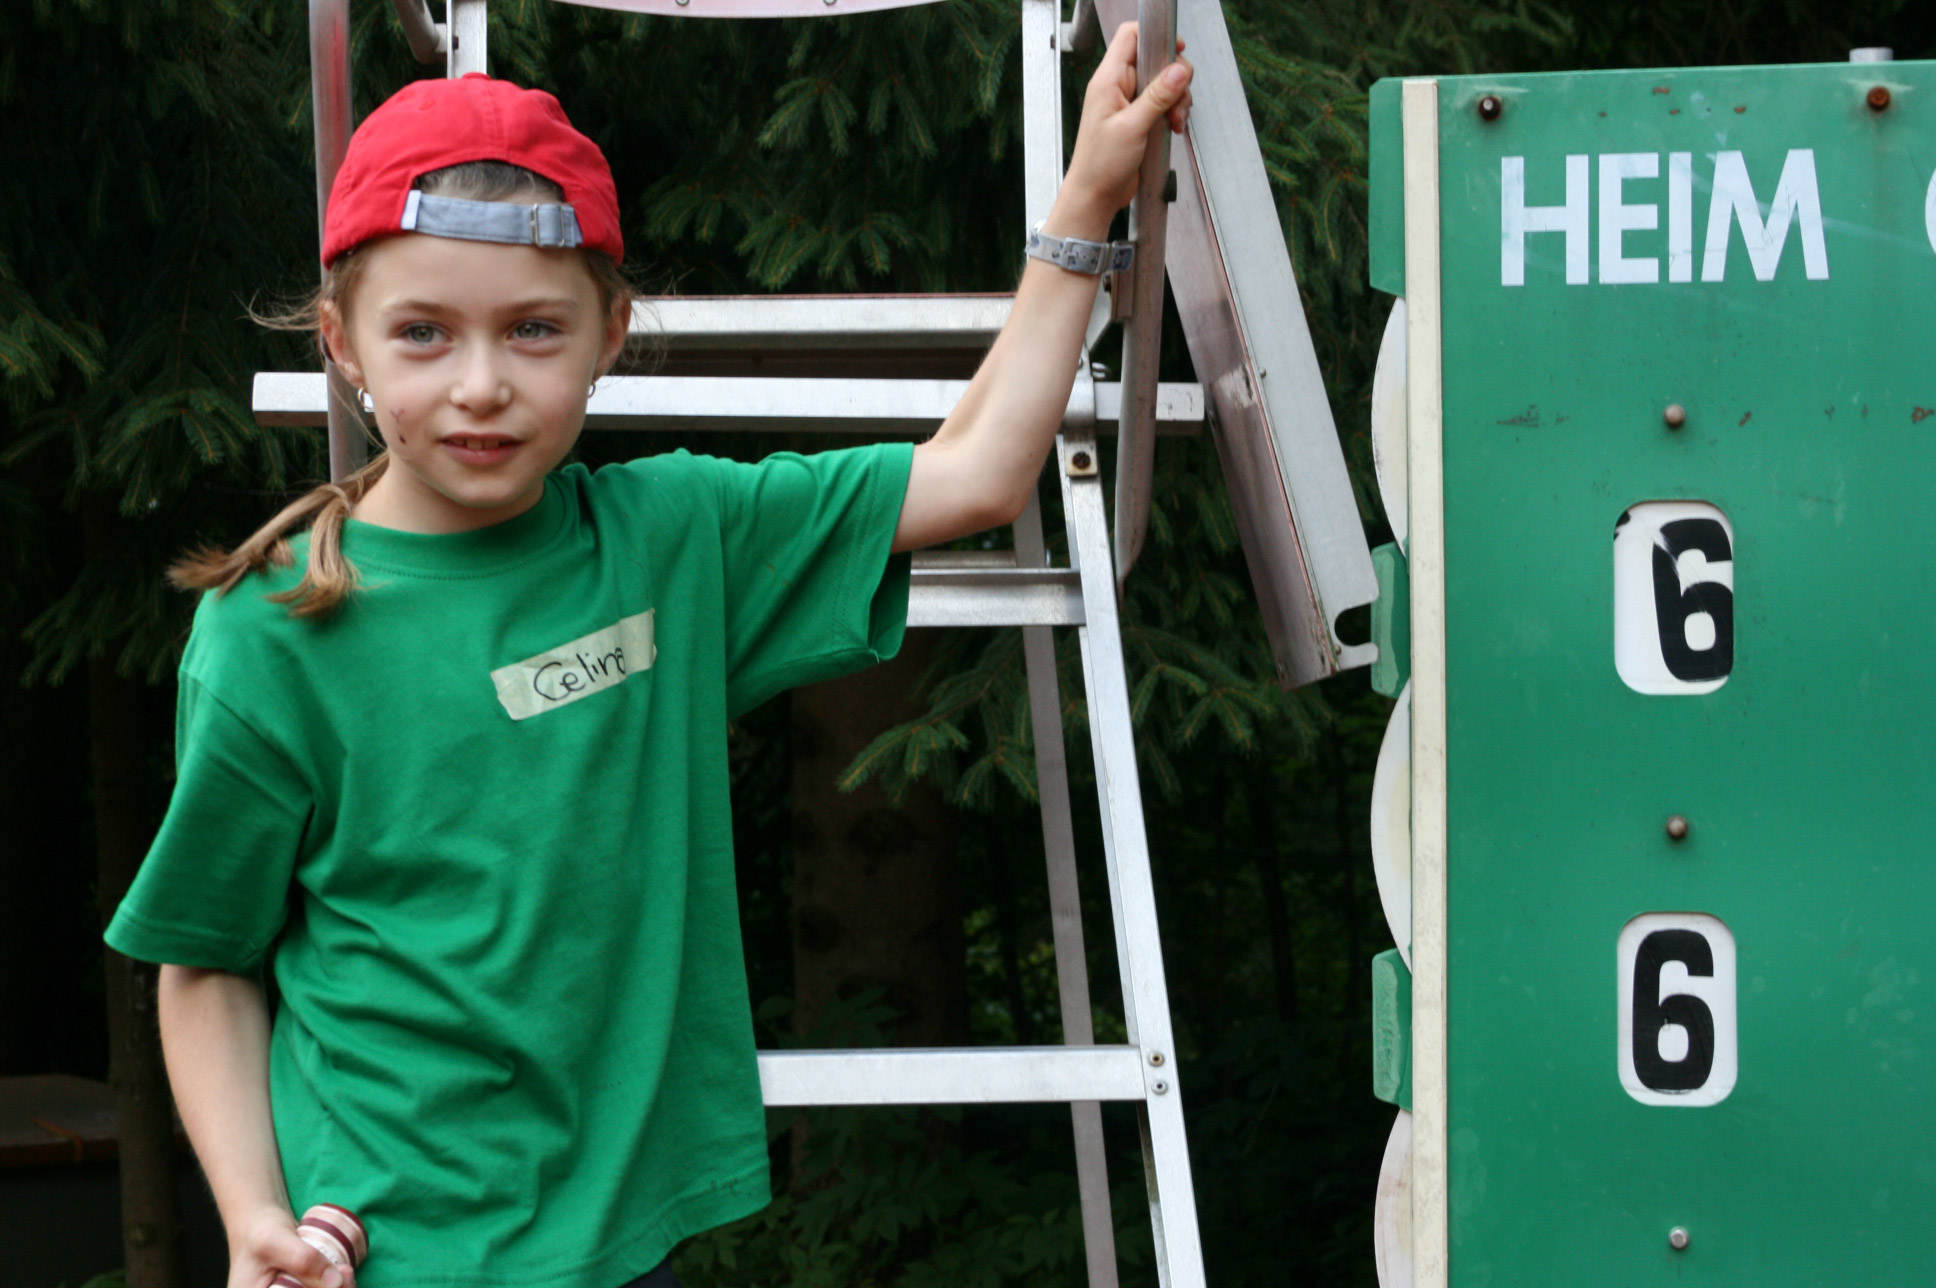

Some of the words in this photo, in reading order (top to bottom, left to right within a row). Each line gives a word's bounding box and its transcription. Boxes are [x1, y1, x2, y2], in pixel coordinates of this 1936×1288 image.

[1501, 149, 1829, 286] HEIM
[1652, 518, 1733, 682] 6
[1632, 928, 1715, 1095] 6
